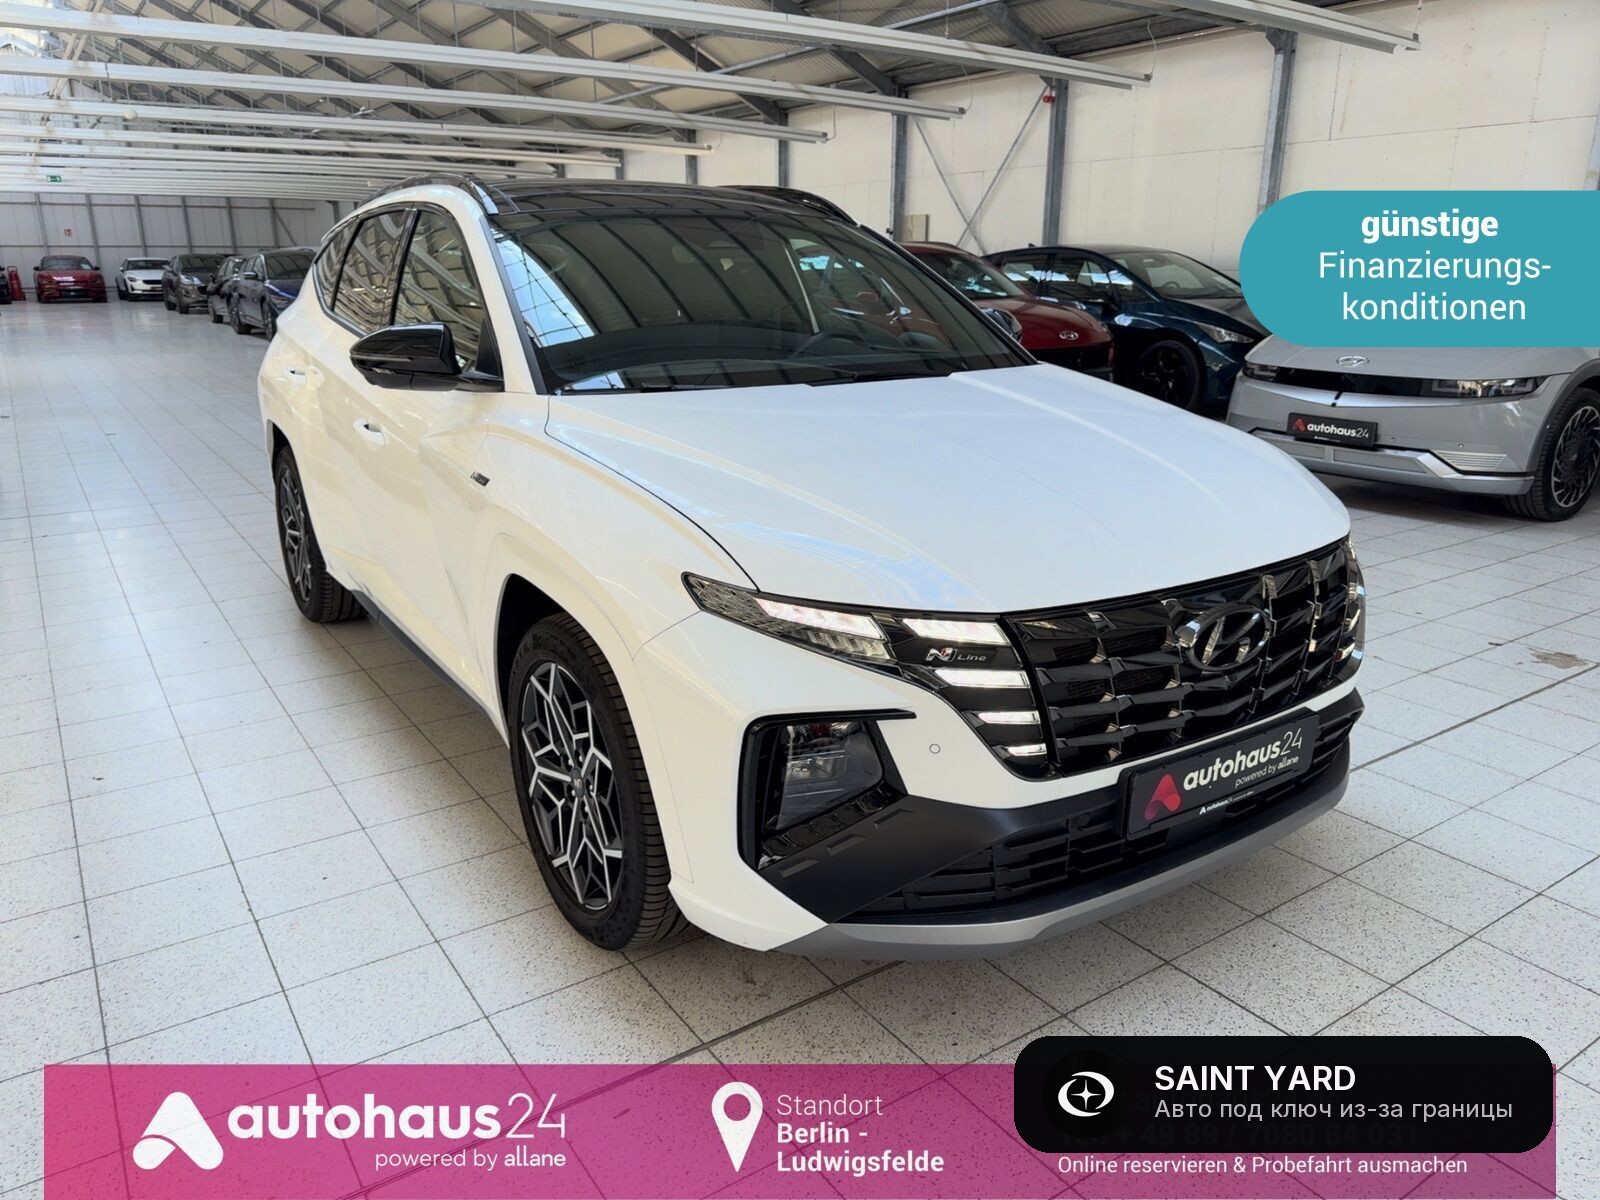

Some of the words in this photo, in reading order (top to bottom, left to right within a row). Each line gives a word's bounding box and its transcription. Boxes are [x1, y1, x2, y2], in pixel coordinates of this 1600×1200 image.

[1307, 423, 1369, 438] autohaus24
[926, 647, 957, 662] N
[957, 654, 987, 662] Line
[1183, 728, 1302, 791] autohaus24
[1235, 768, 1267, 788] powered
[1277, 755, 1299, 770] allane
